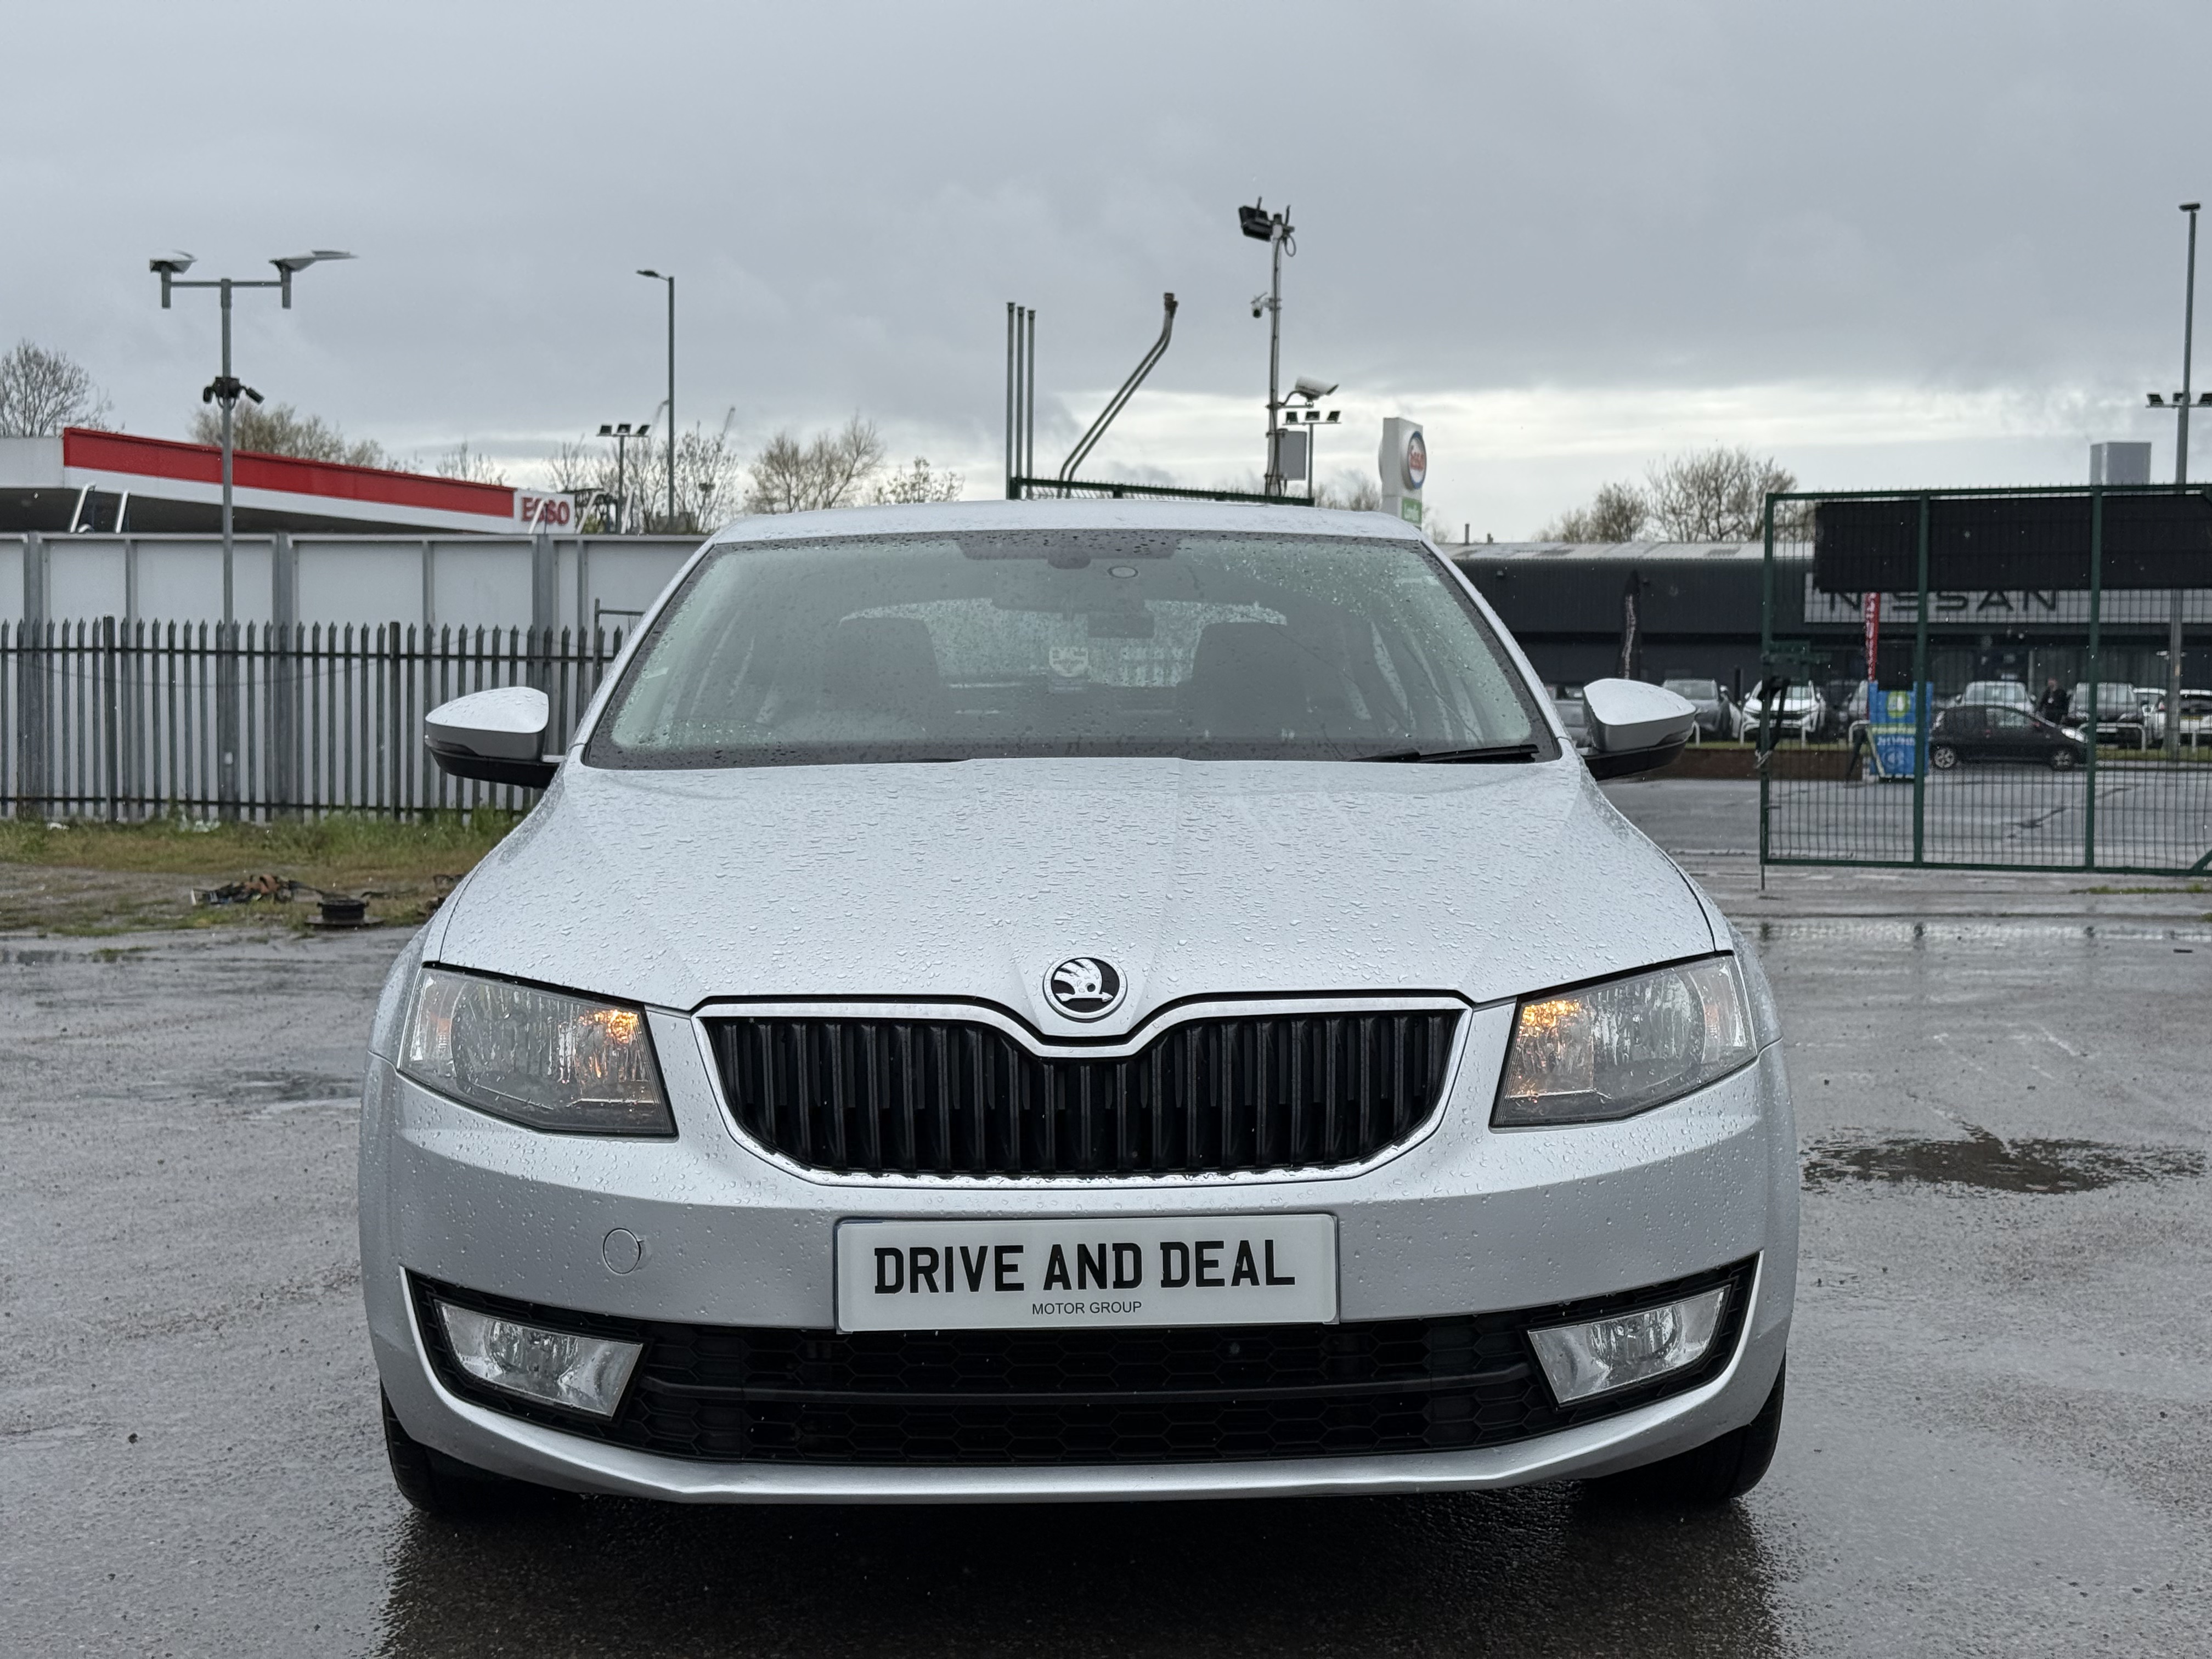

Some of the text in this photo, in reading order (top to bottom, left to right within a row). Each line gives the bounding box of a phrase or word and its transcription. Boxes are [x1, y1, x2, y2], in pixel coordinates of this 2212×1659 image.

[1829, 591, 2056, 611] NSSAN
[873, 1239, 1296, 1294] DRIVE AND DEAL
[1032, 1301, 1142, 1315] MOTOR GROUP
